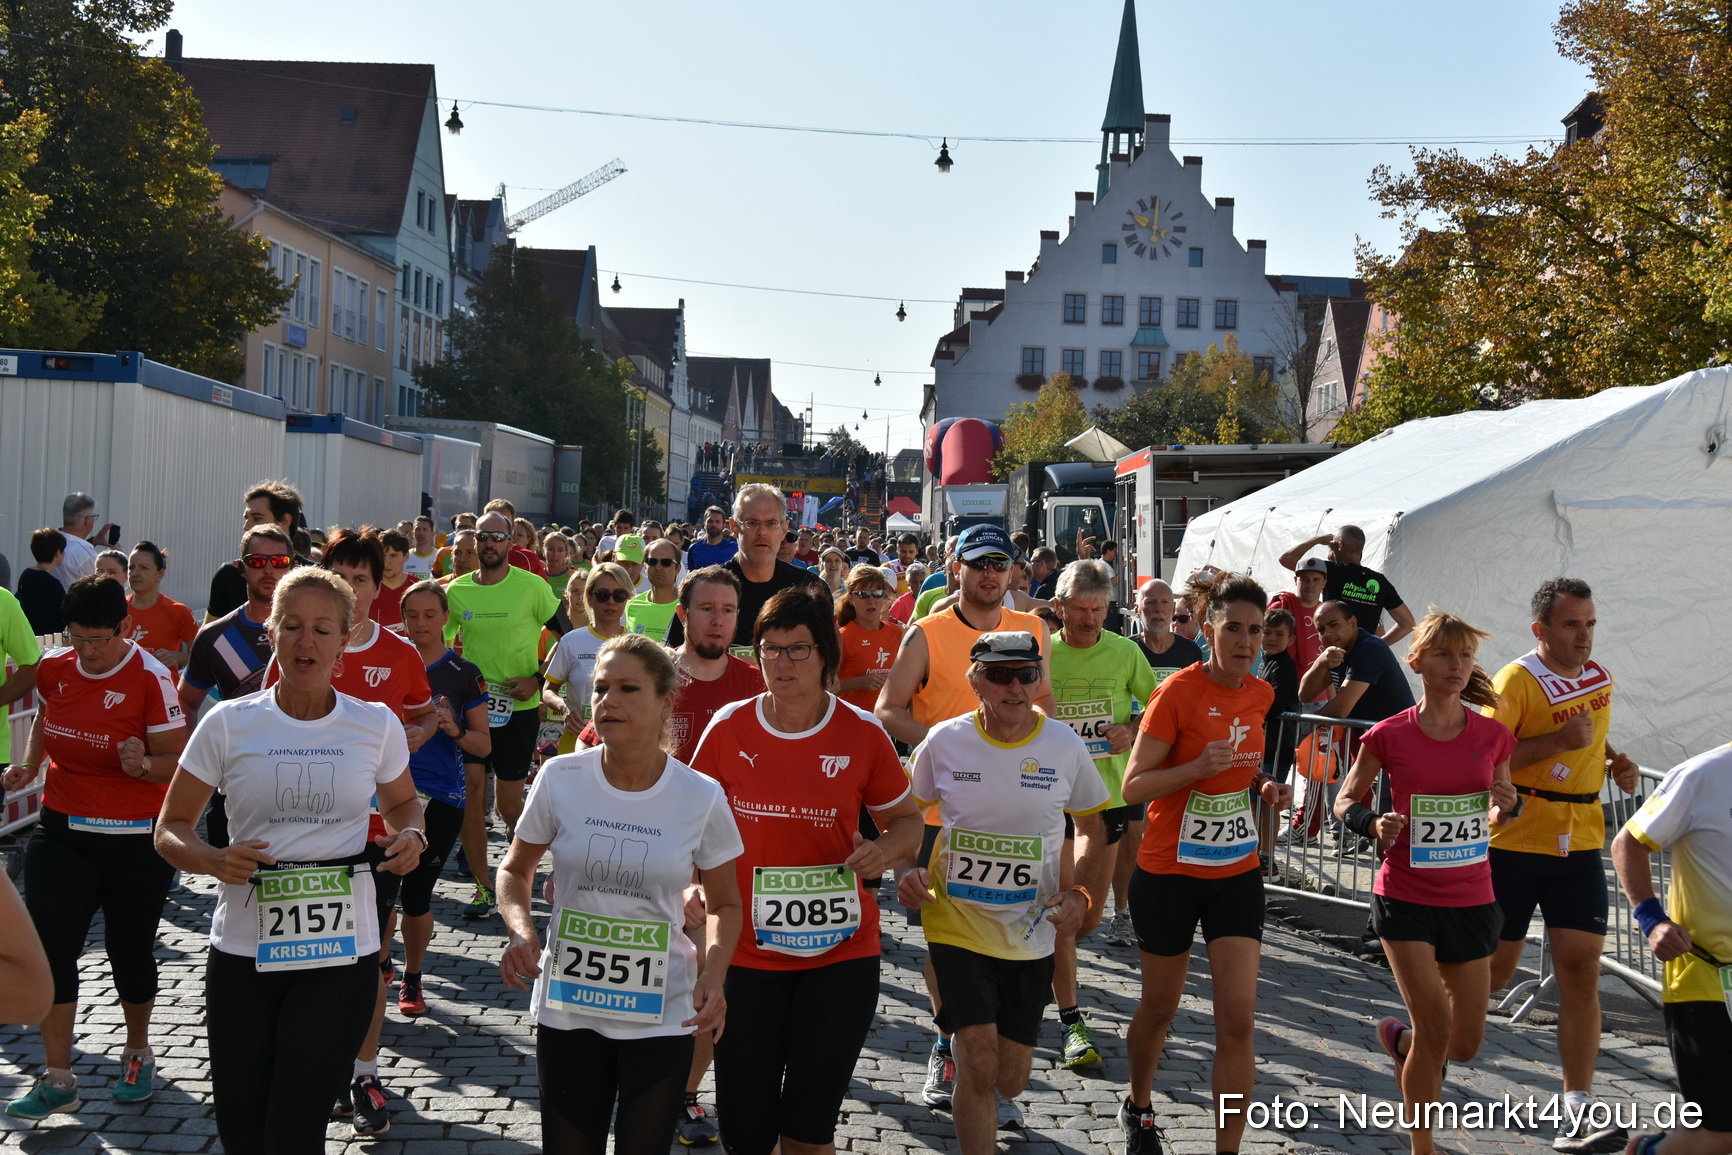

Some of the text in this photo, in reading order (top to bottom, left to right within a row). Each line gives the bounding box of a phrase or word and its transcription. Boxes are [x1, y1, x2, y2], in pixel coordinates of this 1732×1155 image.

[771, 478, 809, 489] START
[1341, 589, 1377, 602] neumarkt
[1343, 582, 1367, 593] physio
[1552, 703, 1586, 725] MAX
[83, 731, 110, 742] WALTER
[268, 748, 344, 757] ZAHNARZTPRAXIS
[1022, 761, 1039, 773] 20
[1020, 781, 1052, 791] Stadtlauf
[1021, 773, 1059, 783] Neumarkter
[733, 795, 837, 817] ENGELHARDT & WALTER
[1192, 792, 1247, 815] BOCK
[1417, 795, 1484, 815] BOCK
[288, 815, 320, 824] GÜNTER
[585, 816, 662, 837] ZAHNARZTPRAXIS
[1190, 816, 1249, 842] 2738
[1421, 818, 1481, 844] 2243
[957, 831, 1036, 858] BOCK
[1429, 847, 1477, 860] RENATE
[761, 869, 848, 892] BOCK
[957, 856, 1031, 887] 2776
[262, 871, 345, 898] BOCK
[577, 884, 652, 902] RALF GÜNTER HELM
[967, 886, 1029, 902] KLEMENS
[268, 901, 343, 937] 2157
[765, 896, 849, 927] 2085
[564, 913, 660, 948] BOCK
[771, 932, 844, 948] BIRGITTA
[269, 941, 343, 960] KRISTINA
[563, 946, 652, 987] 2551
[571, 988, 637, 1009] JUDITH
